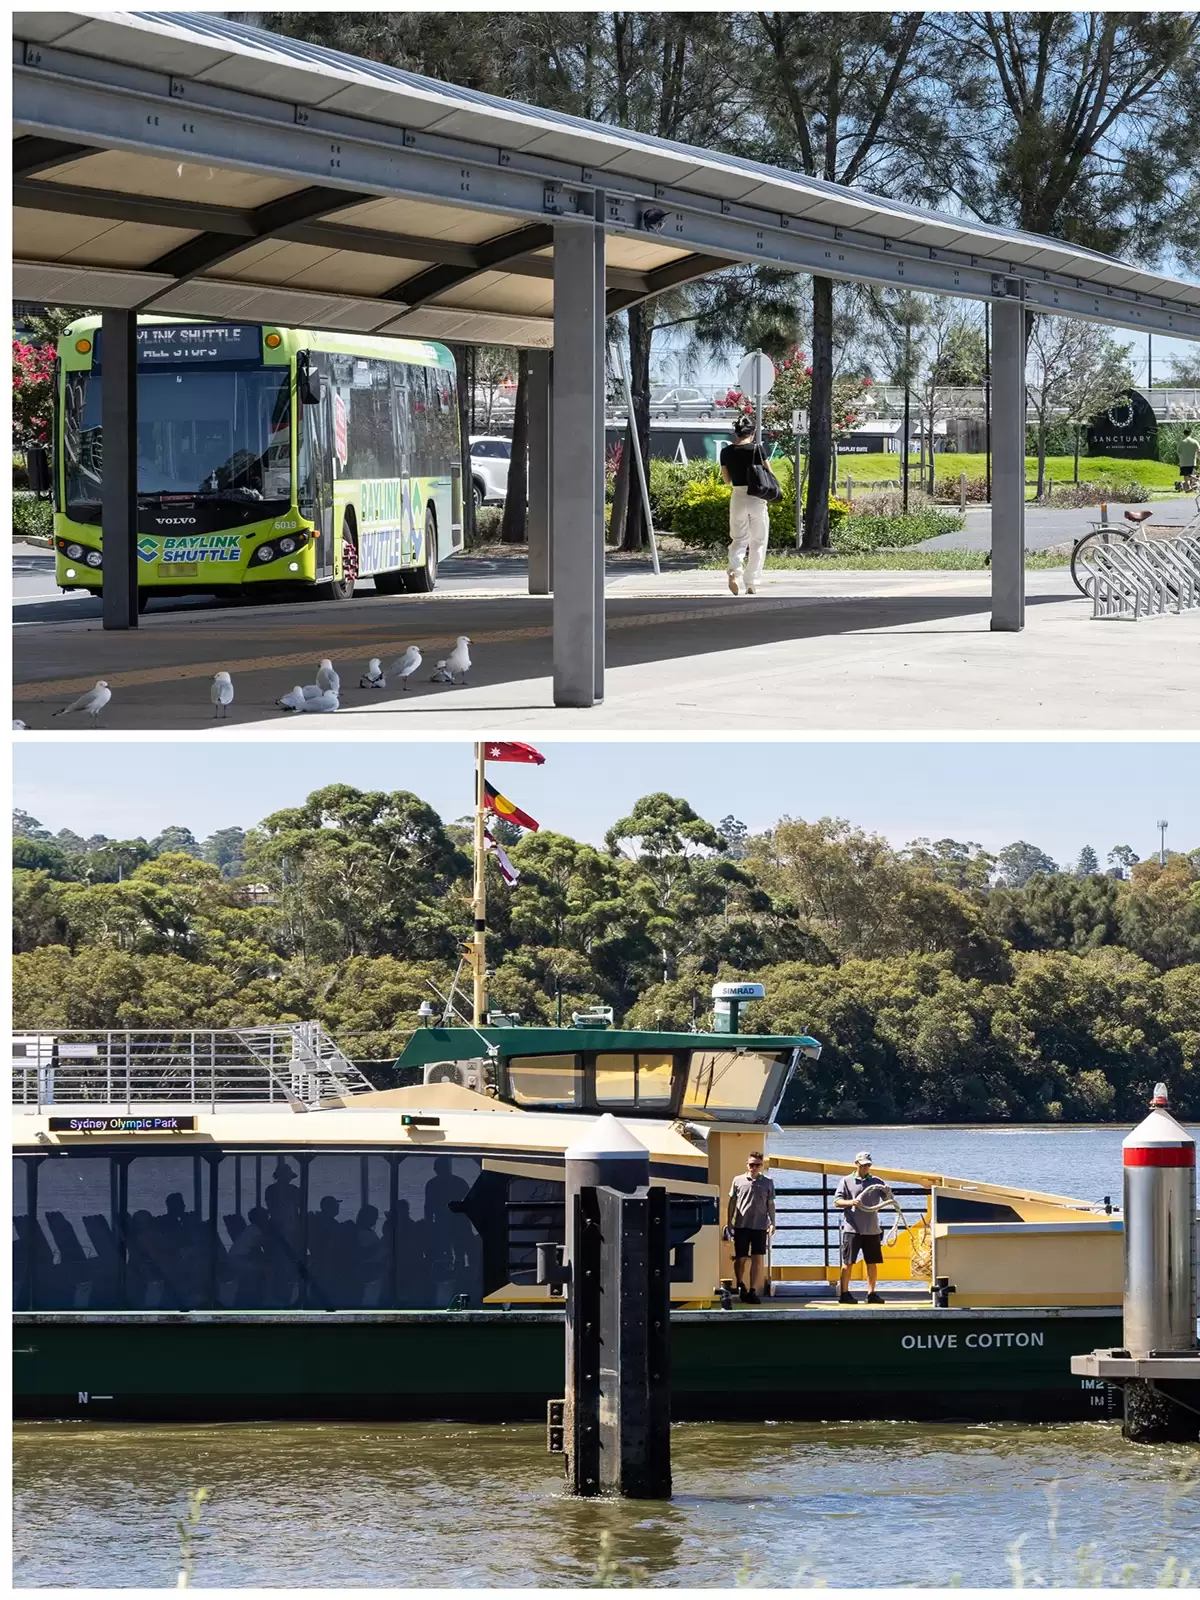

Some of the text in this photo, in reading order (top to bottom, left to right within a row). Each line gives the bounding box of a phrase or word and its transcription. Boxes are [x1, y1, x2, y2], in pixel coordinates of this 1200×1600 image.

[180, 329, 241, 343] SHUTTLE
[1093, 435, 1151, 443] SANCTUARY
[361, 481, 400, 522] BAYLINK
[274, 521, 297, 529] 6019
[163, 535, 243, 549] BAYLINK
[162, 549, 242, 563] SHUTTLE
[362, 528, 400, 573] SHUTTLE
[722, 987, 755, 995] SIMRAD
[70, 1117, 178, 1131] Sydney Olympic Park
[901, 1332, 1044, 1349] OLIVE COTTON
[78, 1391, 88, 1403] N
